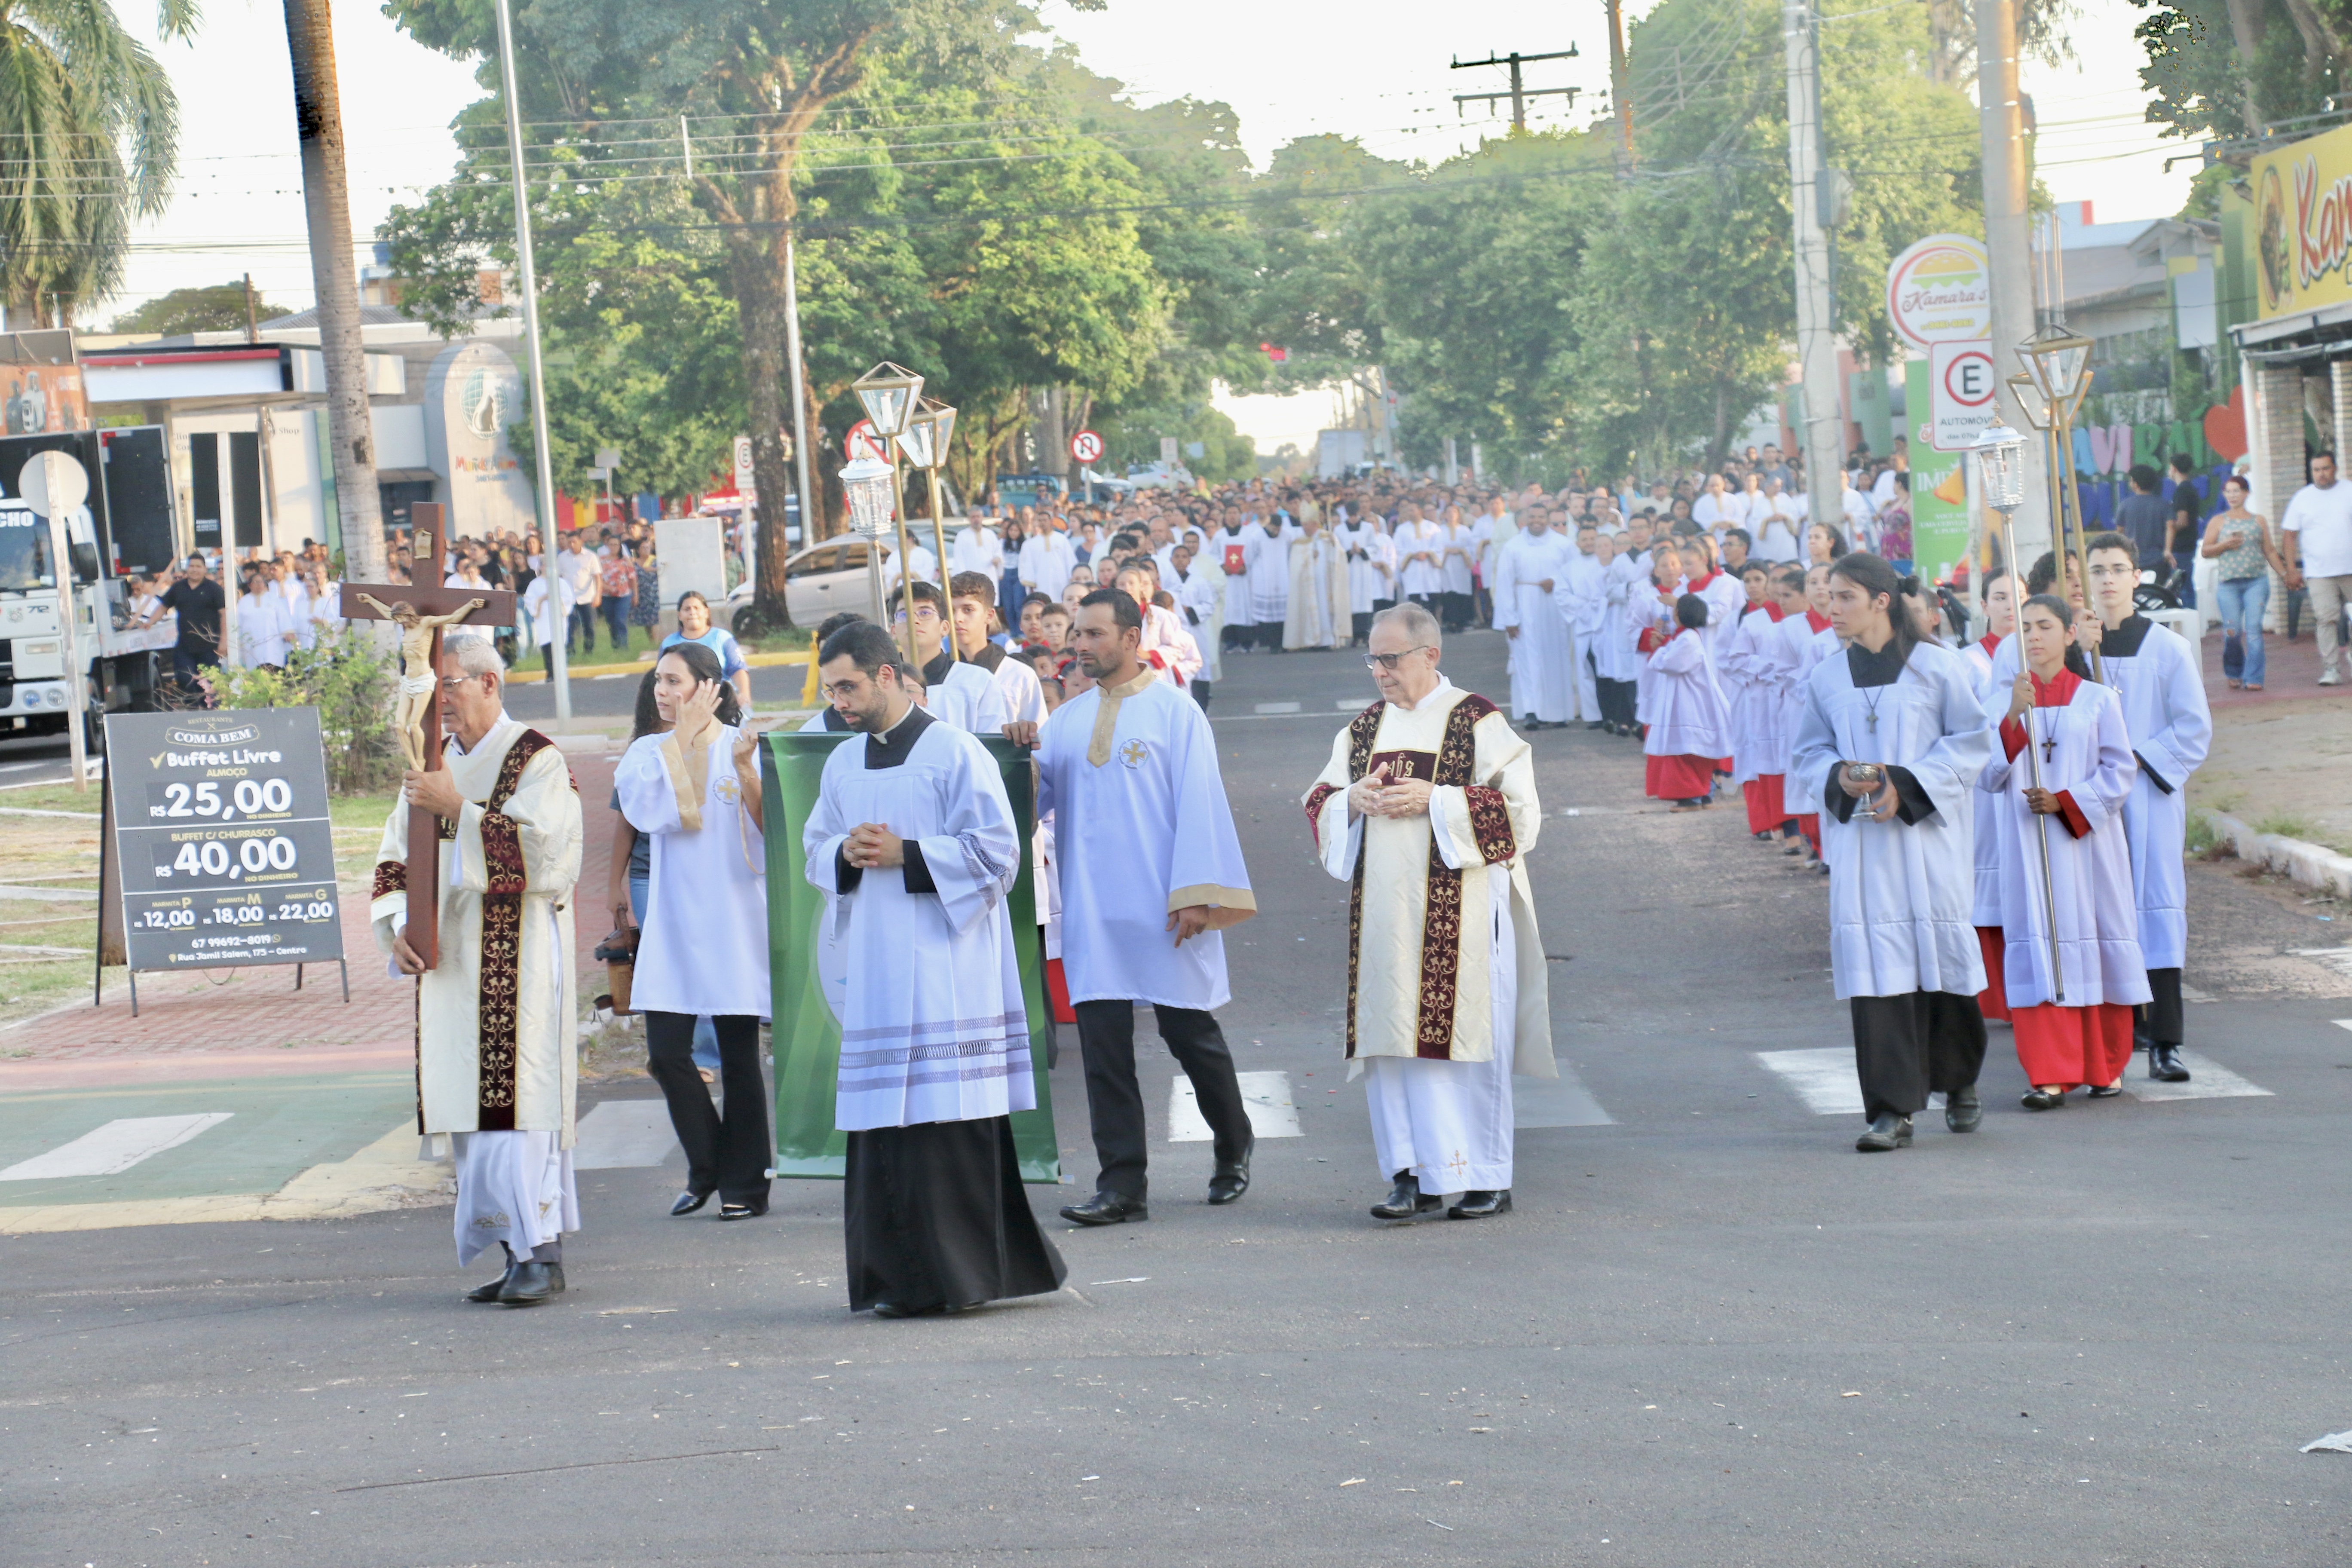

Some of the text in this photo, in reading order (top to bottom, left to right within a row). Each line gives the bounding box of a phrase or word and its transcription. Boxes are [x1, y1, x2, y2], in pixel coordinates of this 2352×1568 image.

[1963, 365, 1982, 394] E
[279, 427, 300, 436] Shop
[174, 729, 252, 744] COMA BEM
[167, 749, 282, 767] Buffet Livre
[206, 768, 248, 778] ALMOÇO
[150, 778, 292, 820] R$ 25,00
[171, 828, 277, 842] BUFFET C/ CHURRASCO
[155, 836, 297, 879] R$ 40,00
[258, 872, 299, 881] DINHEIRO
[247, 893, 262, 905] M
[315, 888, 327, 901] G
[182, 897, 192, 909] P
[212, 905, 264, 925] 18,00
[279, 902, 333, 921] 22,00
[143, 910, 195, 929] 12,00
[191, 934, 271, 949] 67 99692-8019
[177, 953, 194, 962] Rua
[196, 951, 220, 960] Jamil
[221, 949, 251, 959] Salem,
[252, 948, 267, 957] 175
[276, 946, 307, 956] Centro
